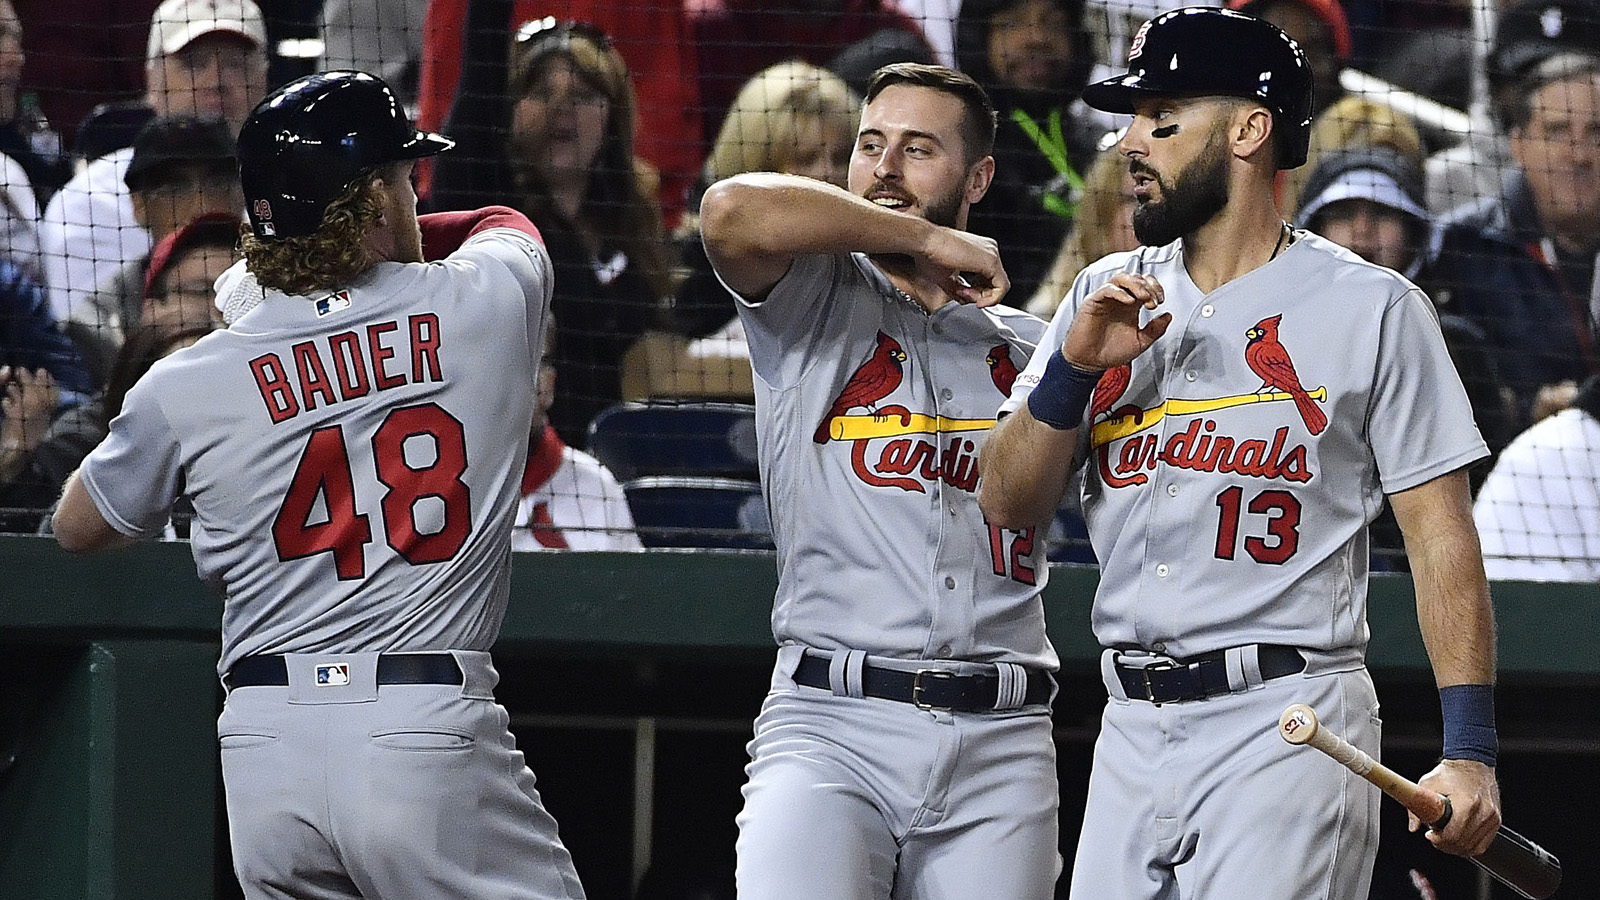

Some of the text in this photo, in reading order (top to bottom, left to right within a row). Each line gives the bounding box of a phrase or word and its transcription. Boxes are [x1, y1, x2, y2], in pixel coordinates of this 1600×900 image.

[248, 312, 444, 425] BADER
[271, 402, 473, 581] 48
[1098, 417, 1314, 489] Cardinals
[1214, 485, 1302, 565] 13
